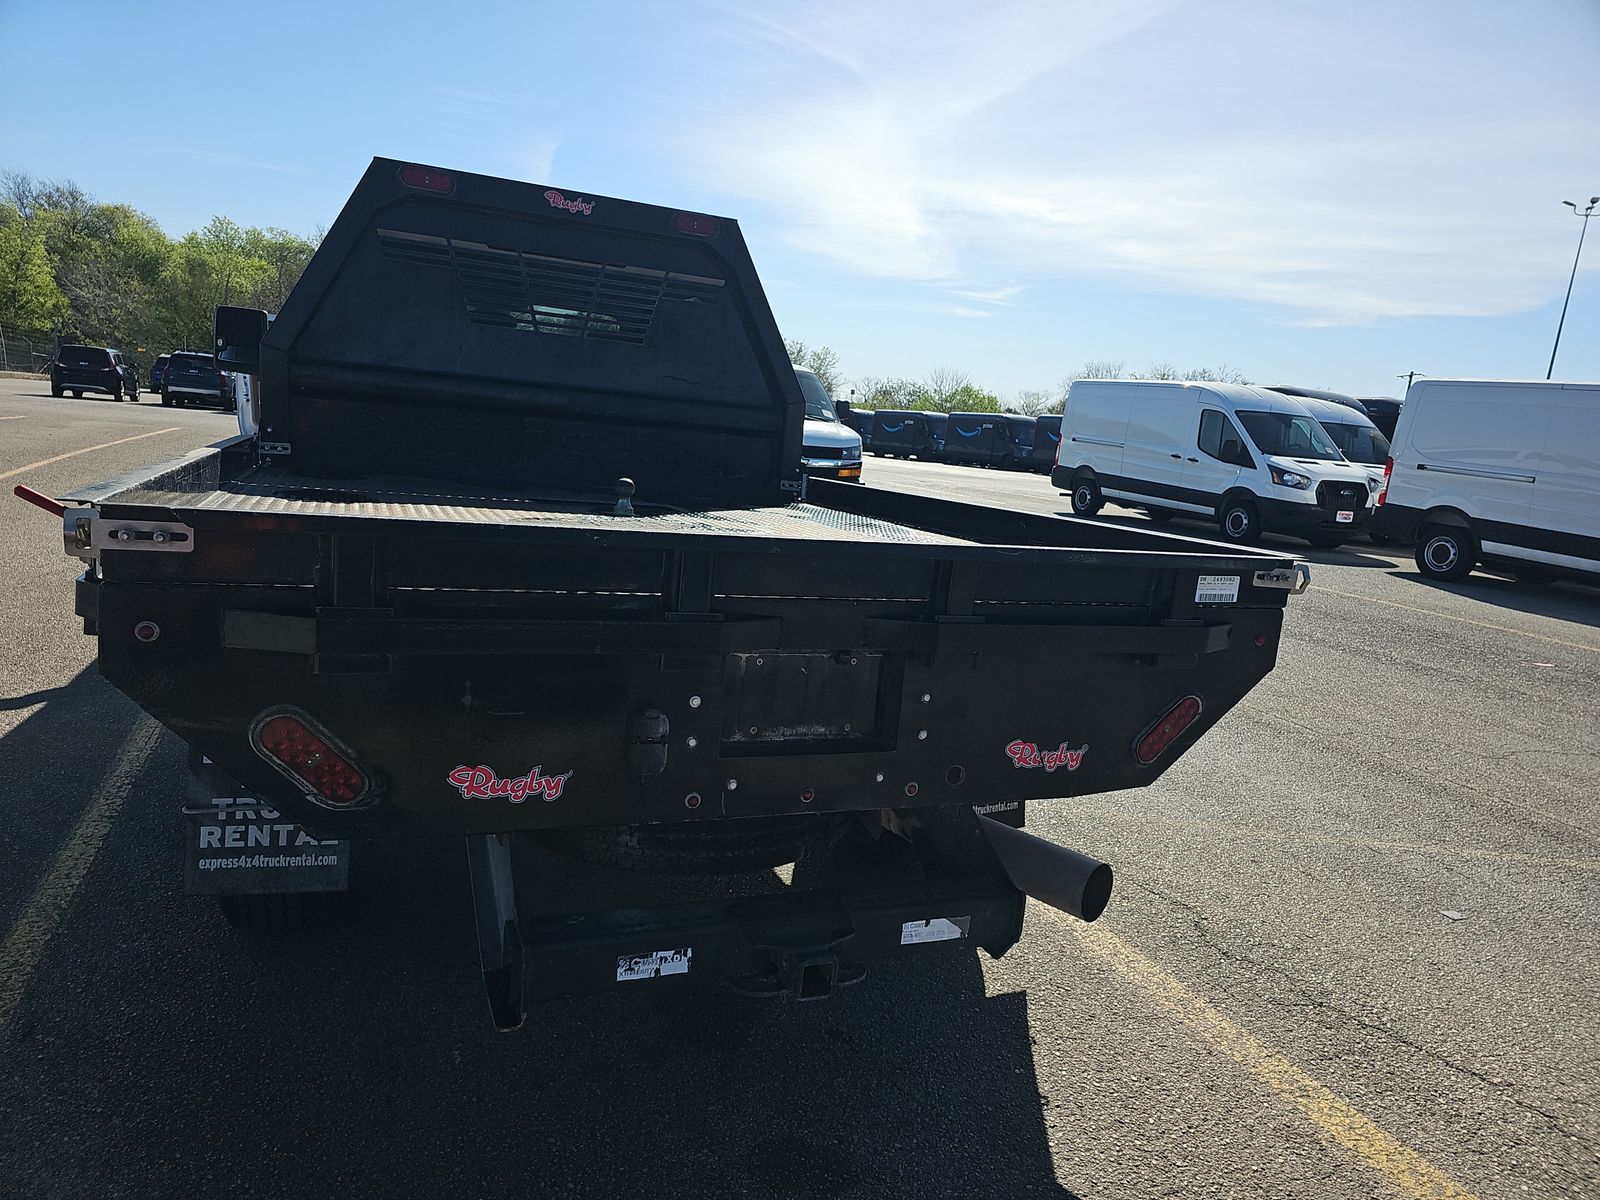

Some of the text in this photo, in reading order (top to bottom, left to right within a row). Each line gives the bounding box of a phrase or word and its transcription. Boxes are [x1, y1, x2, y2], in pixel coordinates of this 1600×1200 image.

[544, 191, 594, 215] Rugby
[1005, 740, 1085, 772] Rugby
[447, 764, 570, 803] Rugby
[200, 825, 339, 848] RENTA
[199, 853, 338, 871] express4x4truckrental.com
